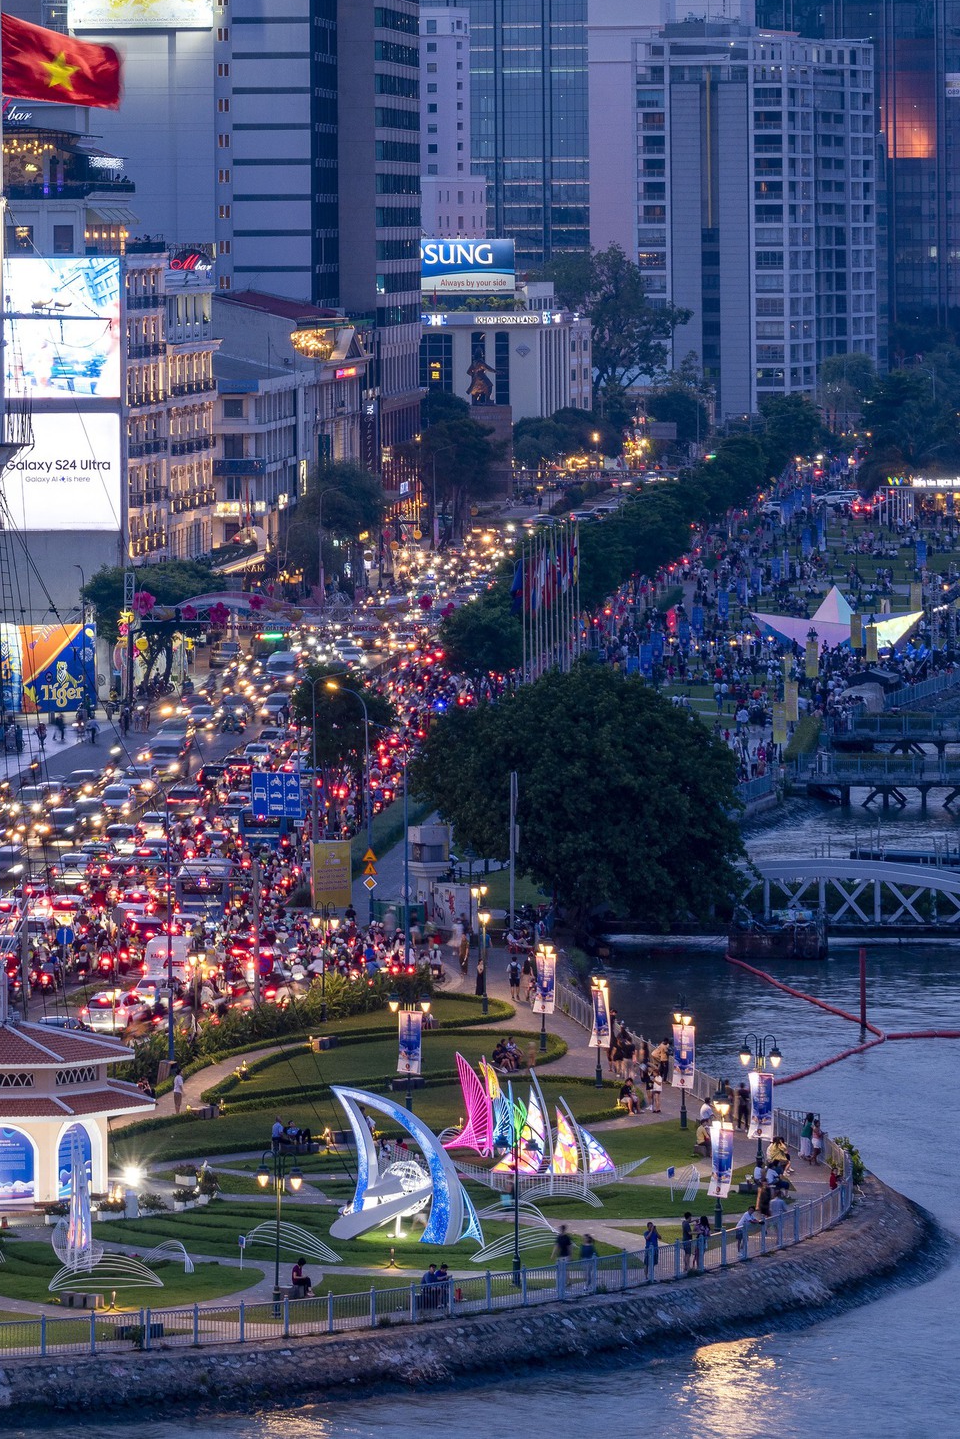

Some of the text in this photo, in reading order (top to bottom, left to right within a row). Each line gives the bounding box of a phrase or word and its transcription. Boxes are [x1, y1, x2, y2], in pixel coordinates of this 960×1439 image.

[8, 106, 32, 121] bar
[421, 244, 493, 264] SUNG
[194, 260, 212, 271] bar
[440, 279, 465, 287] Always
[466, 279, 475, 287] by
[493, 279, 507, 287] side
[6, 459, 111, 473] Galaxy S24 Ultra
[25, 476, 49, 484] Galaxy
[41, 682, 84, 707] Tiger
